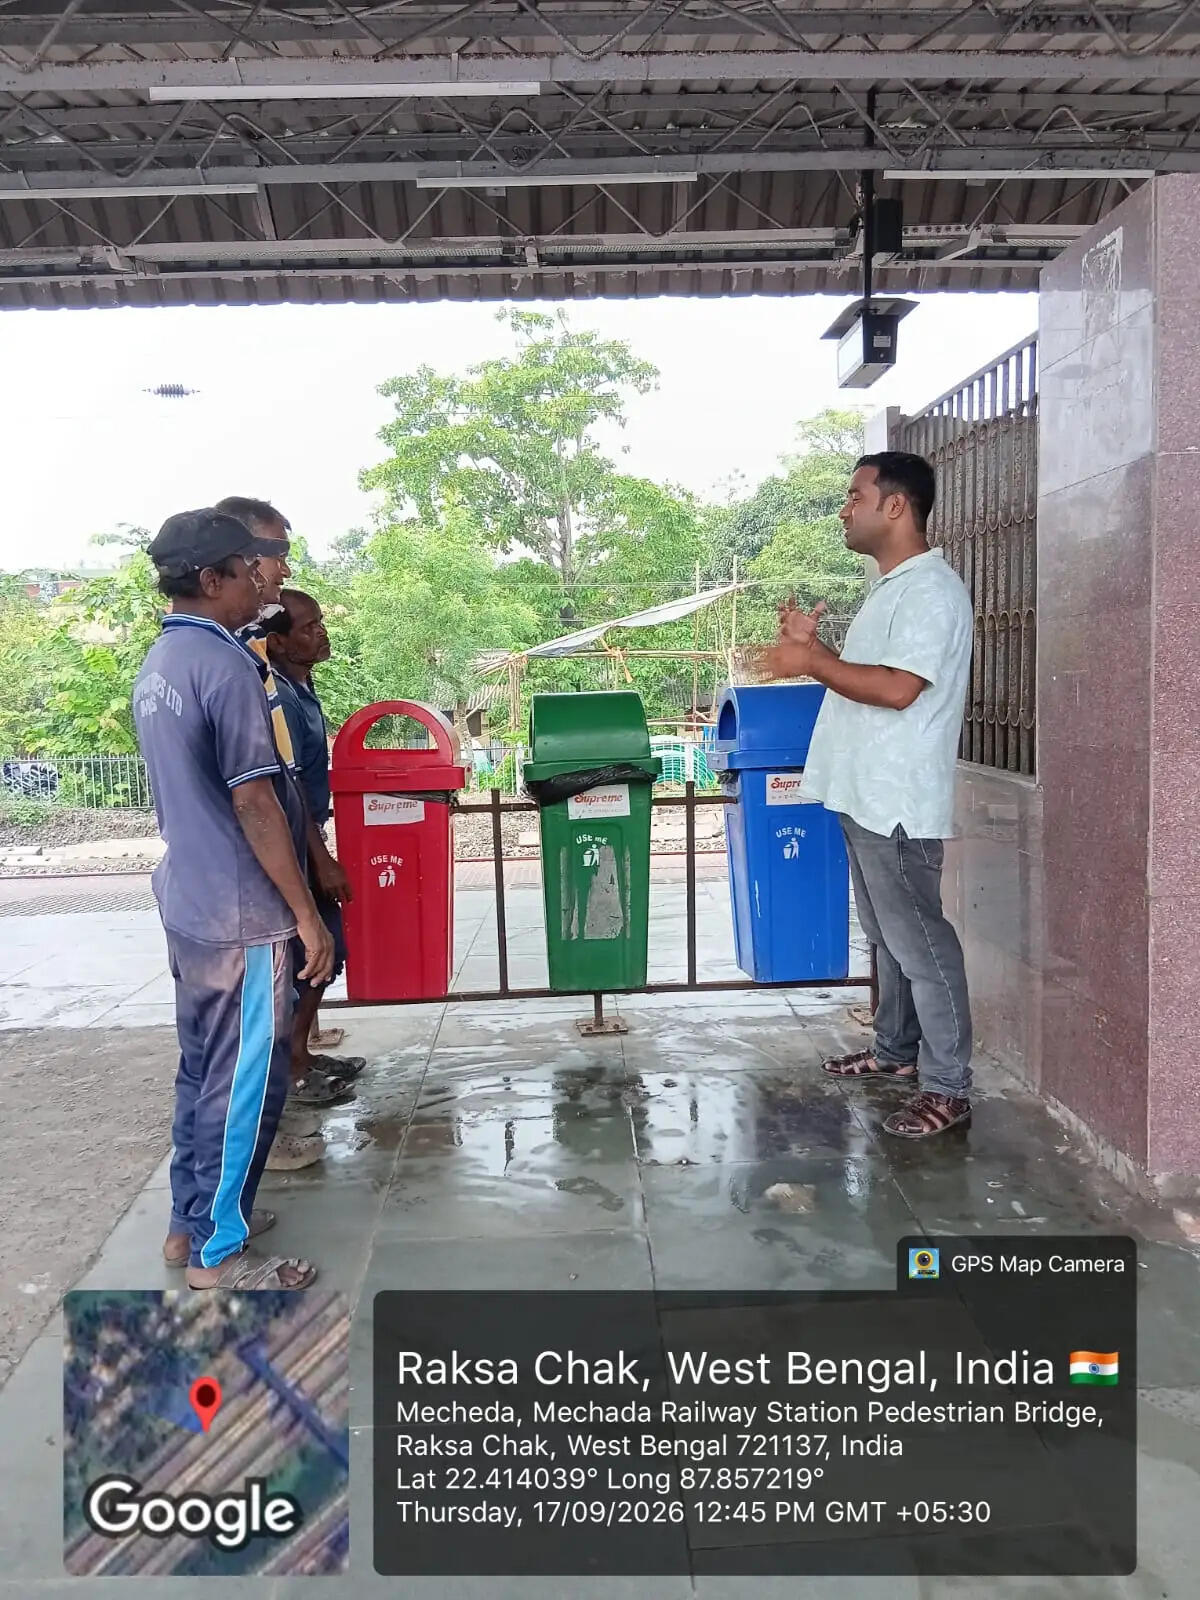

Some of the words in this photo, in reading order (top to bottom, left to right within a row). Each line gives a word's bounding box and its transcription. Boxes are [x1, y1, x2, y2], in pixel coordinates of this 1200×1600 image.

[165, 684, 183, 717] LTD
[367, 799, 419, 812] Supreme
[574, 792, 623, 806] Supreme
[776, 826, 793, 838] USE
[794, 827, 807, 838] ME
[576, 834, 593, 845] USE
[370, 854, 389, 866] USE
[390, 855, 404, 867] ME
